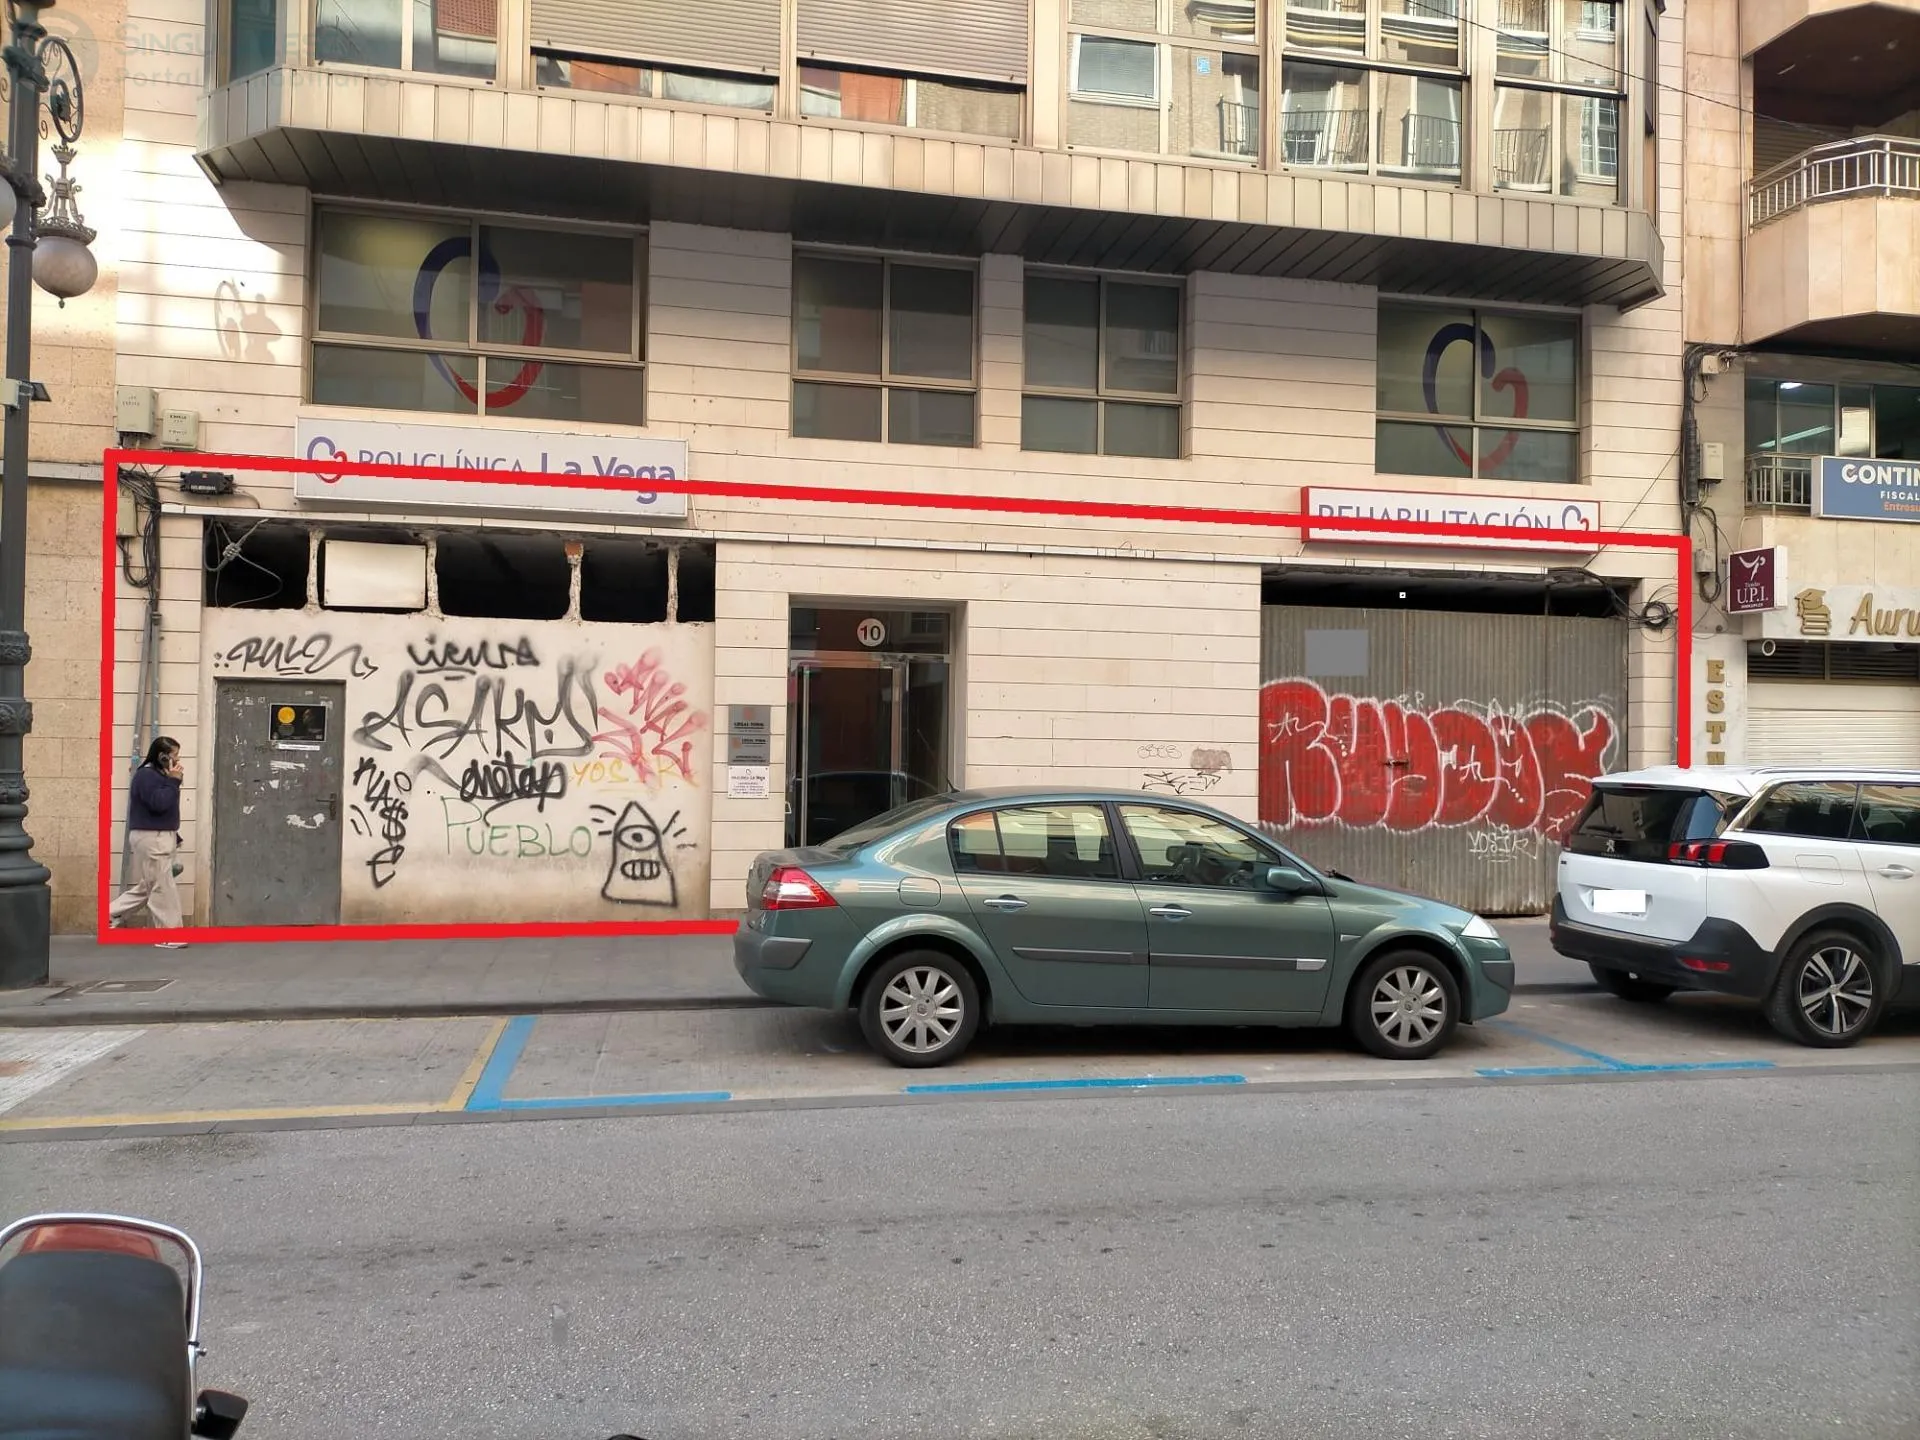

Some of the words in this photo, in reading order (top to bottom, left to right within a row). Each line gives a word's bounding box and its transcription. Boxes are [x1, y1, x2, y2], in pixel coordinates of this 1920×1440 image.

[592, 456, 676, 504] Vega
[859, 625, 881, 642] 10
[441, 796, 592, 858] PUEBLO
